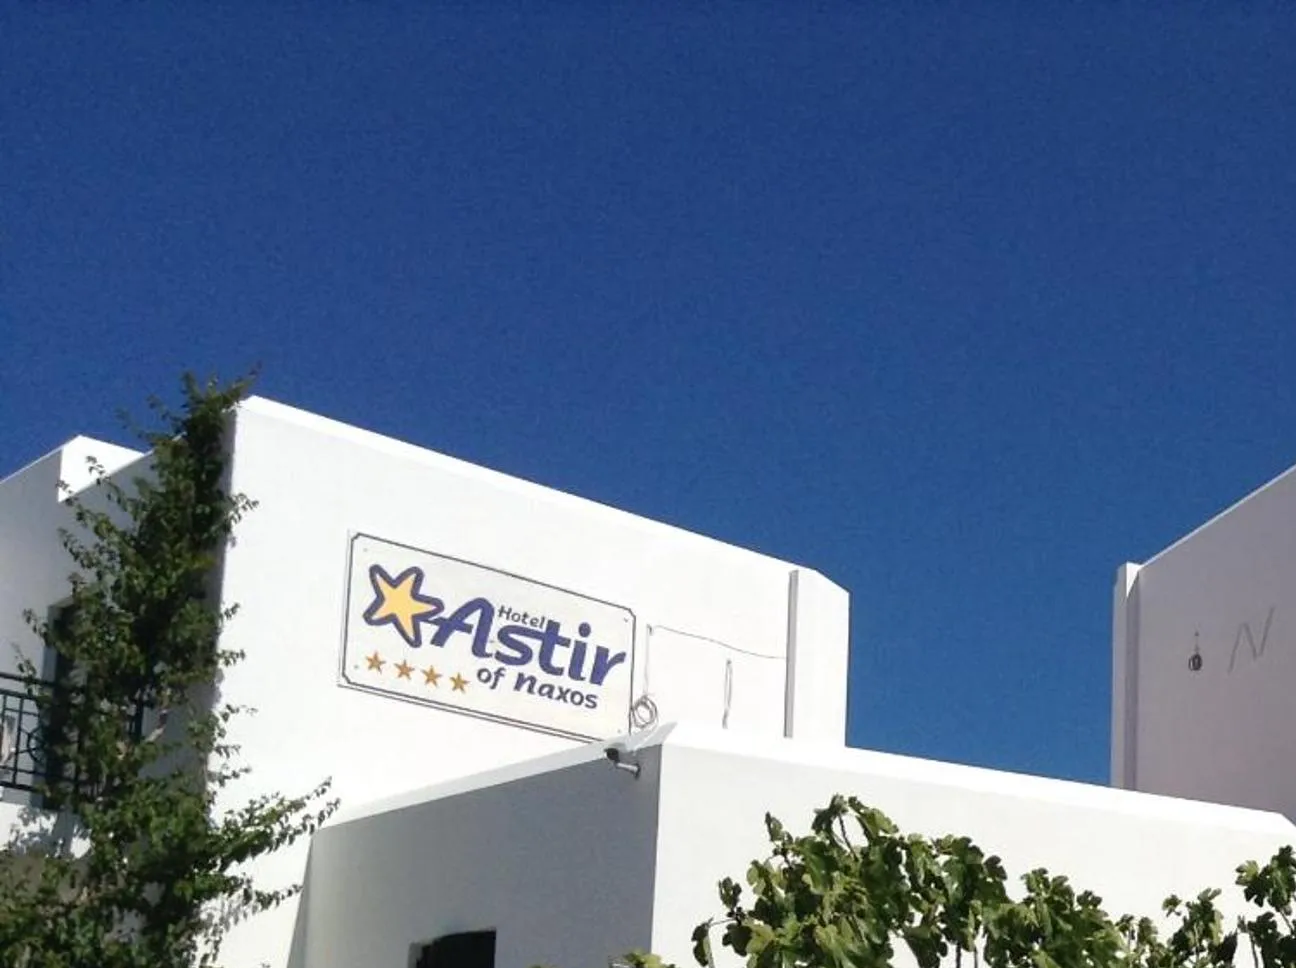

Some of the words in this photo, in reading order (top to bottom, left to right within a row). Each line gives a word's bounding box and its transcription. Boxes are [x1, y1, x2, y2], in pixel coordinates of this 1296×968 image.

[498, 605, 545, 629] Hotel
[428, 597, 626, 686] Astir
[476, 667, 506, 690] of
[513, 672, 598, 709] naxos
